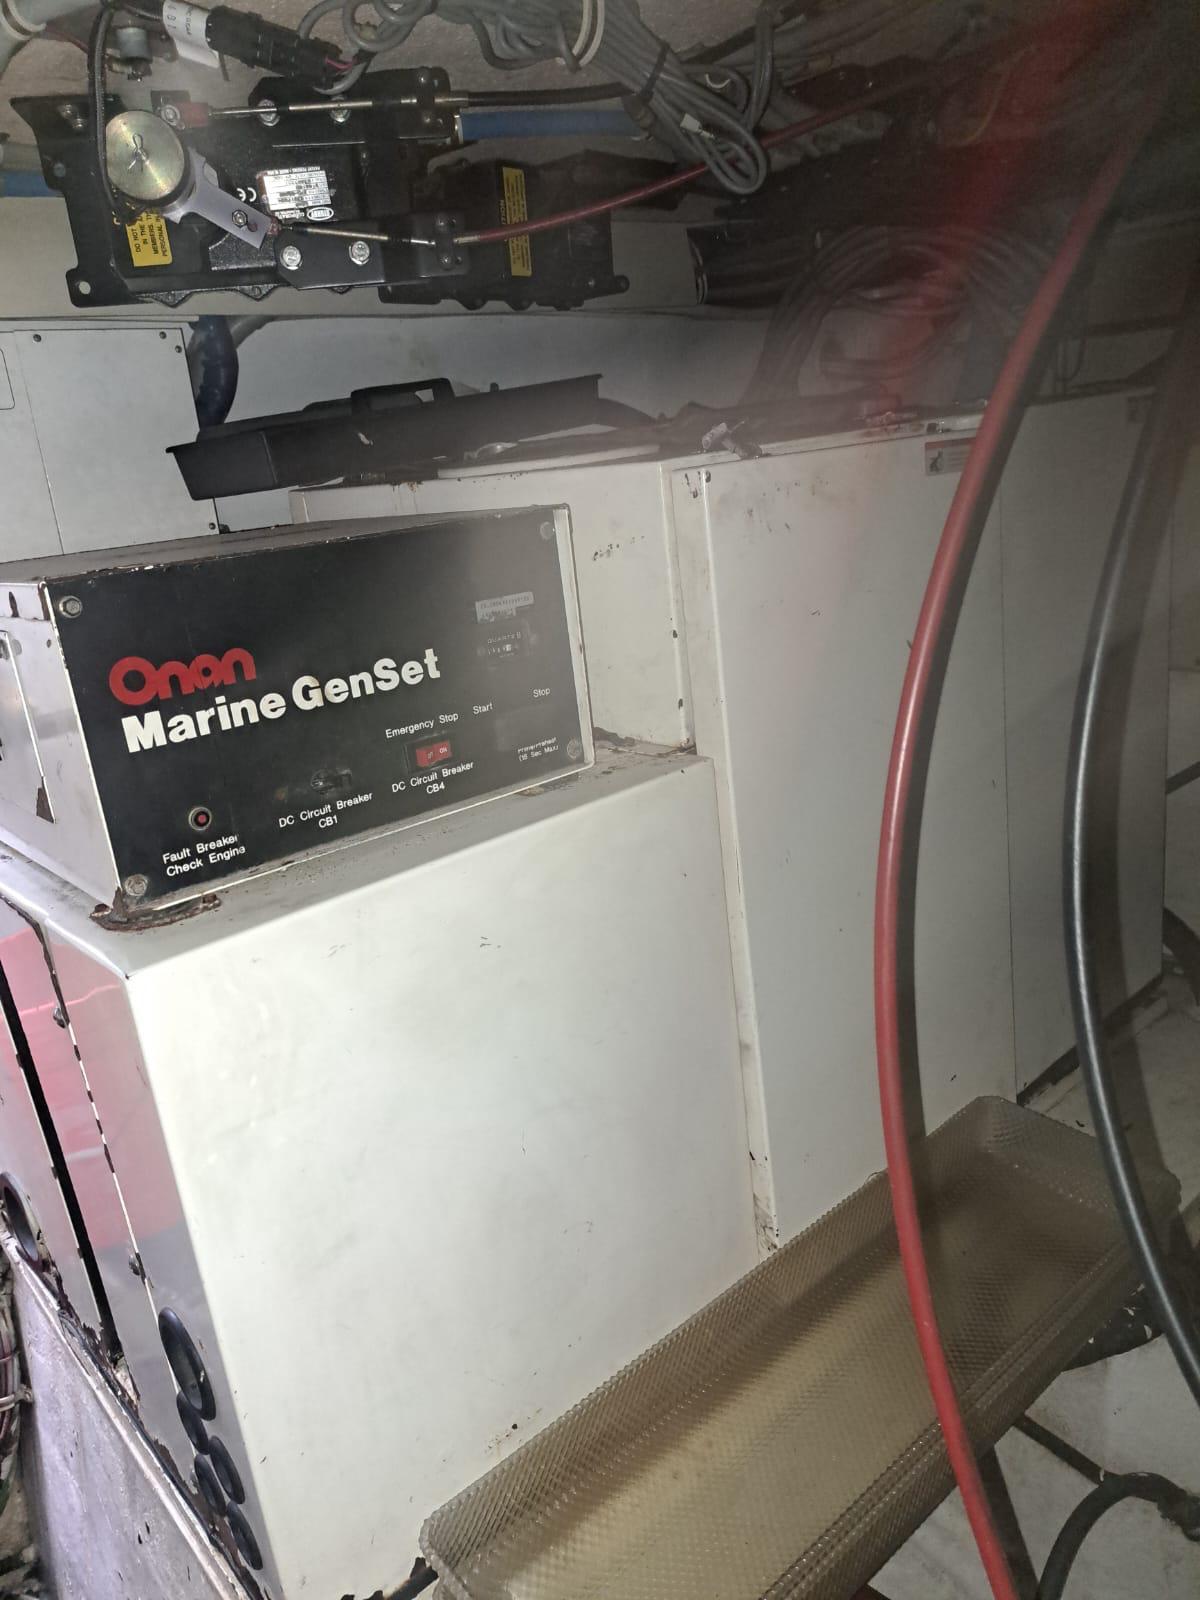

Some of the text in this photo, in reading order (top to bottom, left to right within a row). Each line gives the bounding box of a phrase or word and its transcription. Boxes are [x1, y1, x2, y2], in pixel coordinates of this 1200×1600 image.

[109, 648, 256, 705] Onan
[121, 648, 441, 753] Marine GenSet
[533, 687, 551, 698] Stop
[472, 702, 493, 715] Start
[385, 713, 459, 739] Emergency Stop
[530, 750, 542, 758] Sec
[391, 762, 474, 793] DC Circuit Breaker
[426, 781, 446, 794] CB4
[278, 793, 373, 828] DC Circuit Breaker
[318, 815, 338, 828] CB1
[162, 834, 240, 865] Fault Breaker
[166, 846, 246, 877] Check Engine
